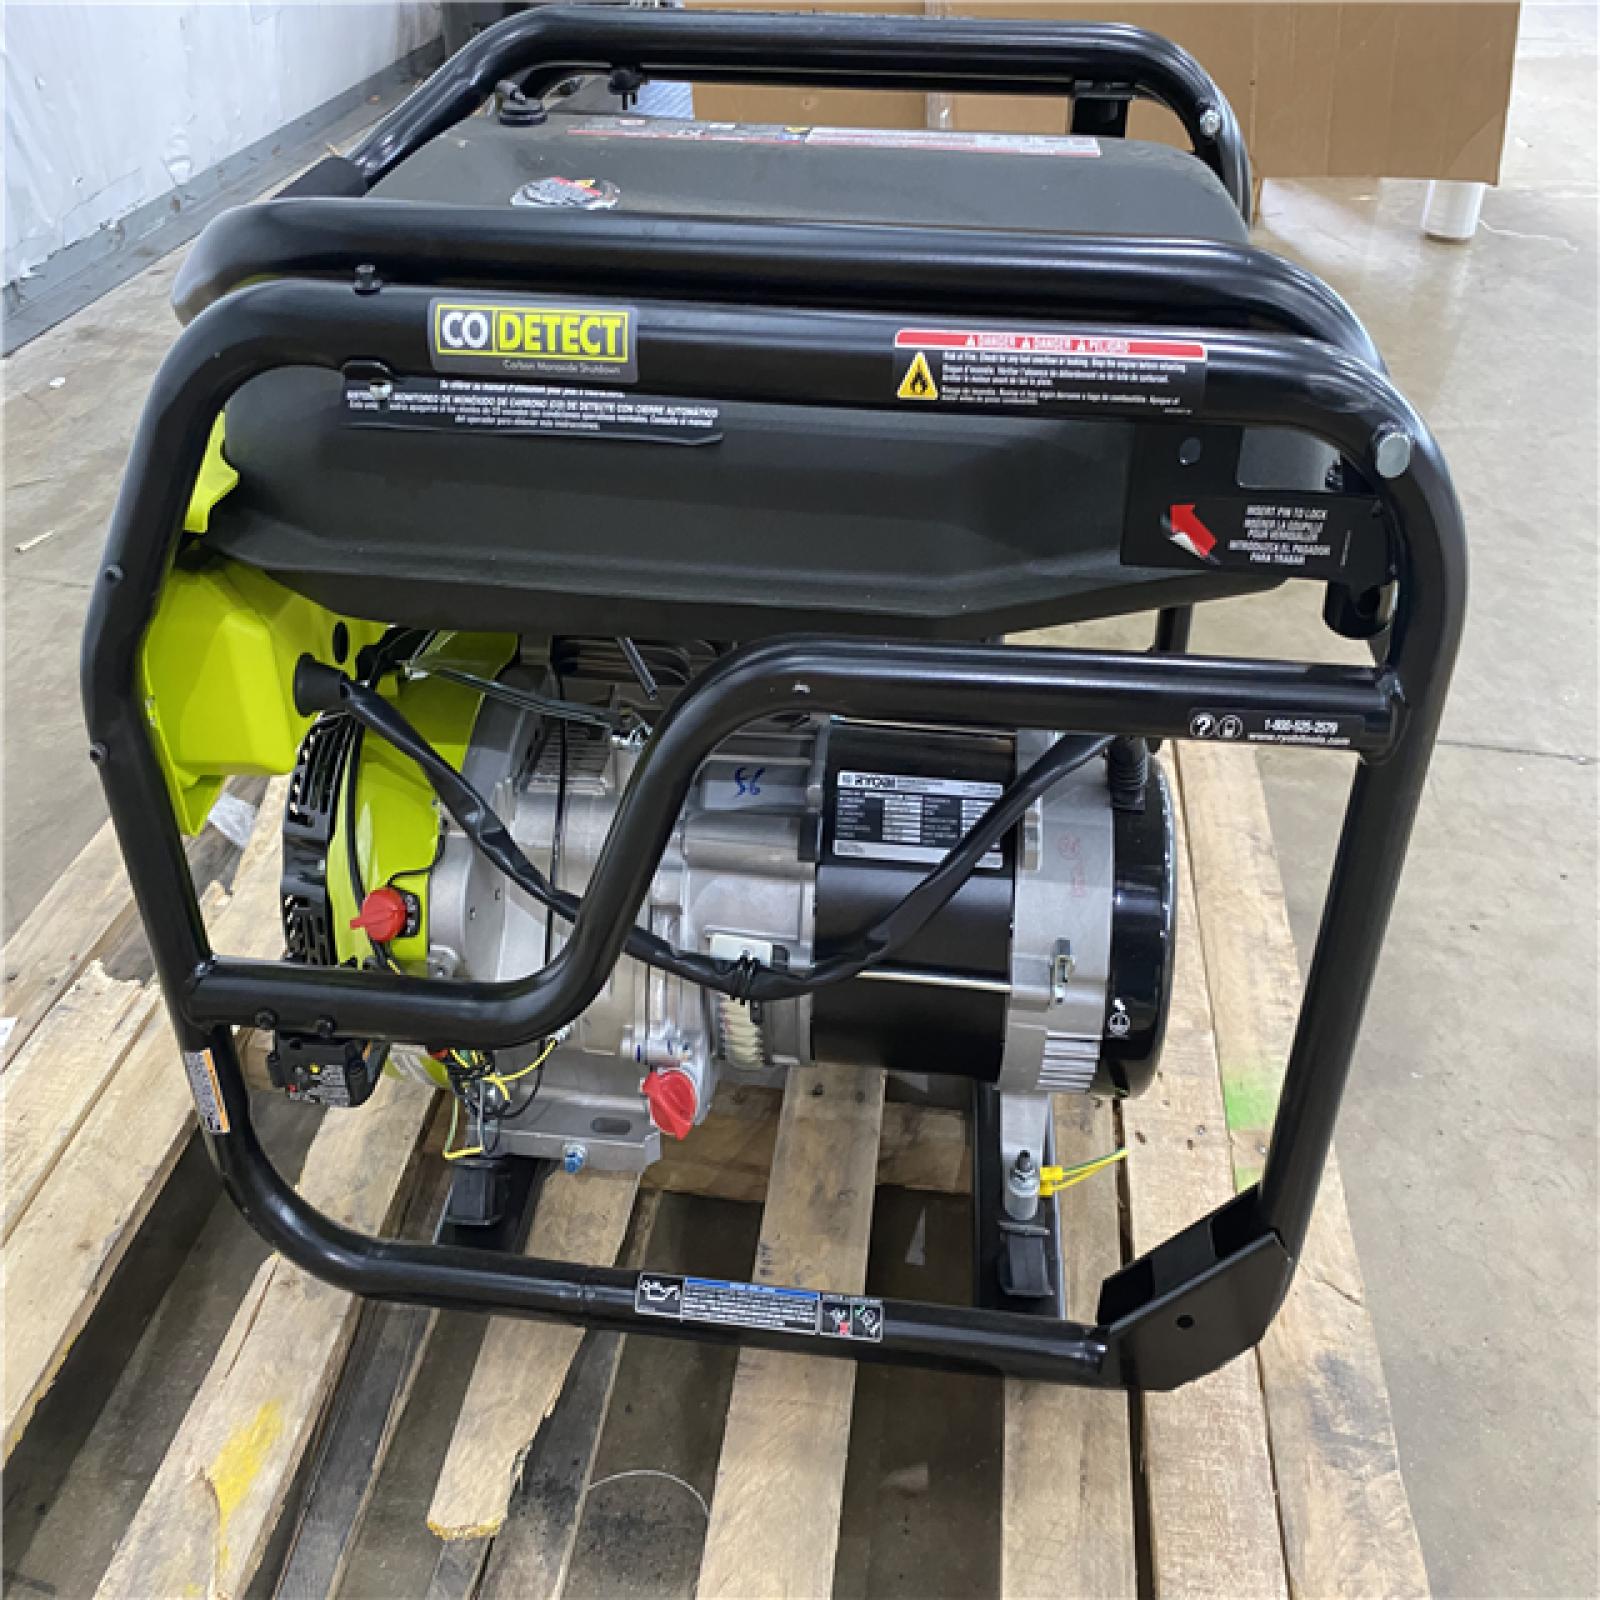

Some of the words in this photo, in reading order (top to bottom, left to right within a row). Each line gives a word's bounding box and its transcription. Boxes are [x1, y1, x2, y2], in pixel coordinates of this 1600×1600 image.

[442, 311, 489, 349] CO
[499, 313, 621, 355] DETECT
[503, 359, 536, 371] Carbon
[537, 361, 579, 373] Monoxide
[580, 363, 621, 375] Shutdown
